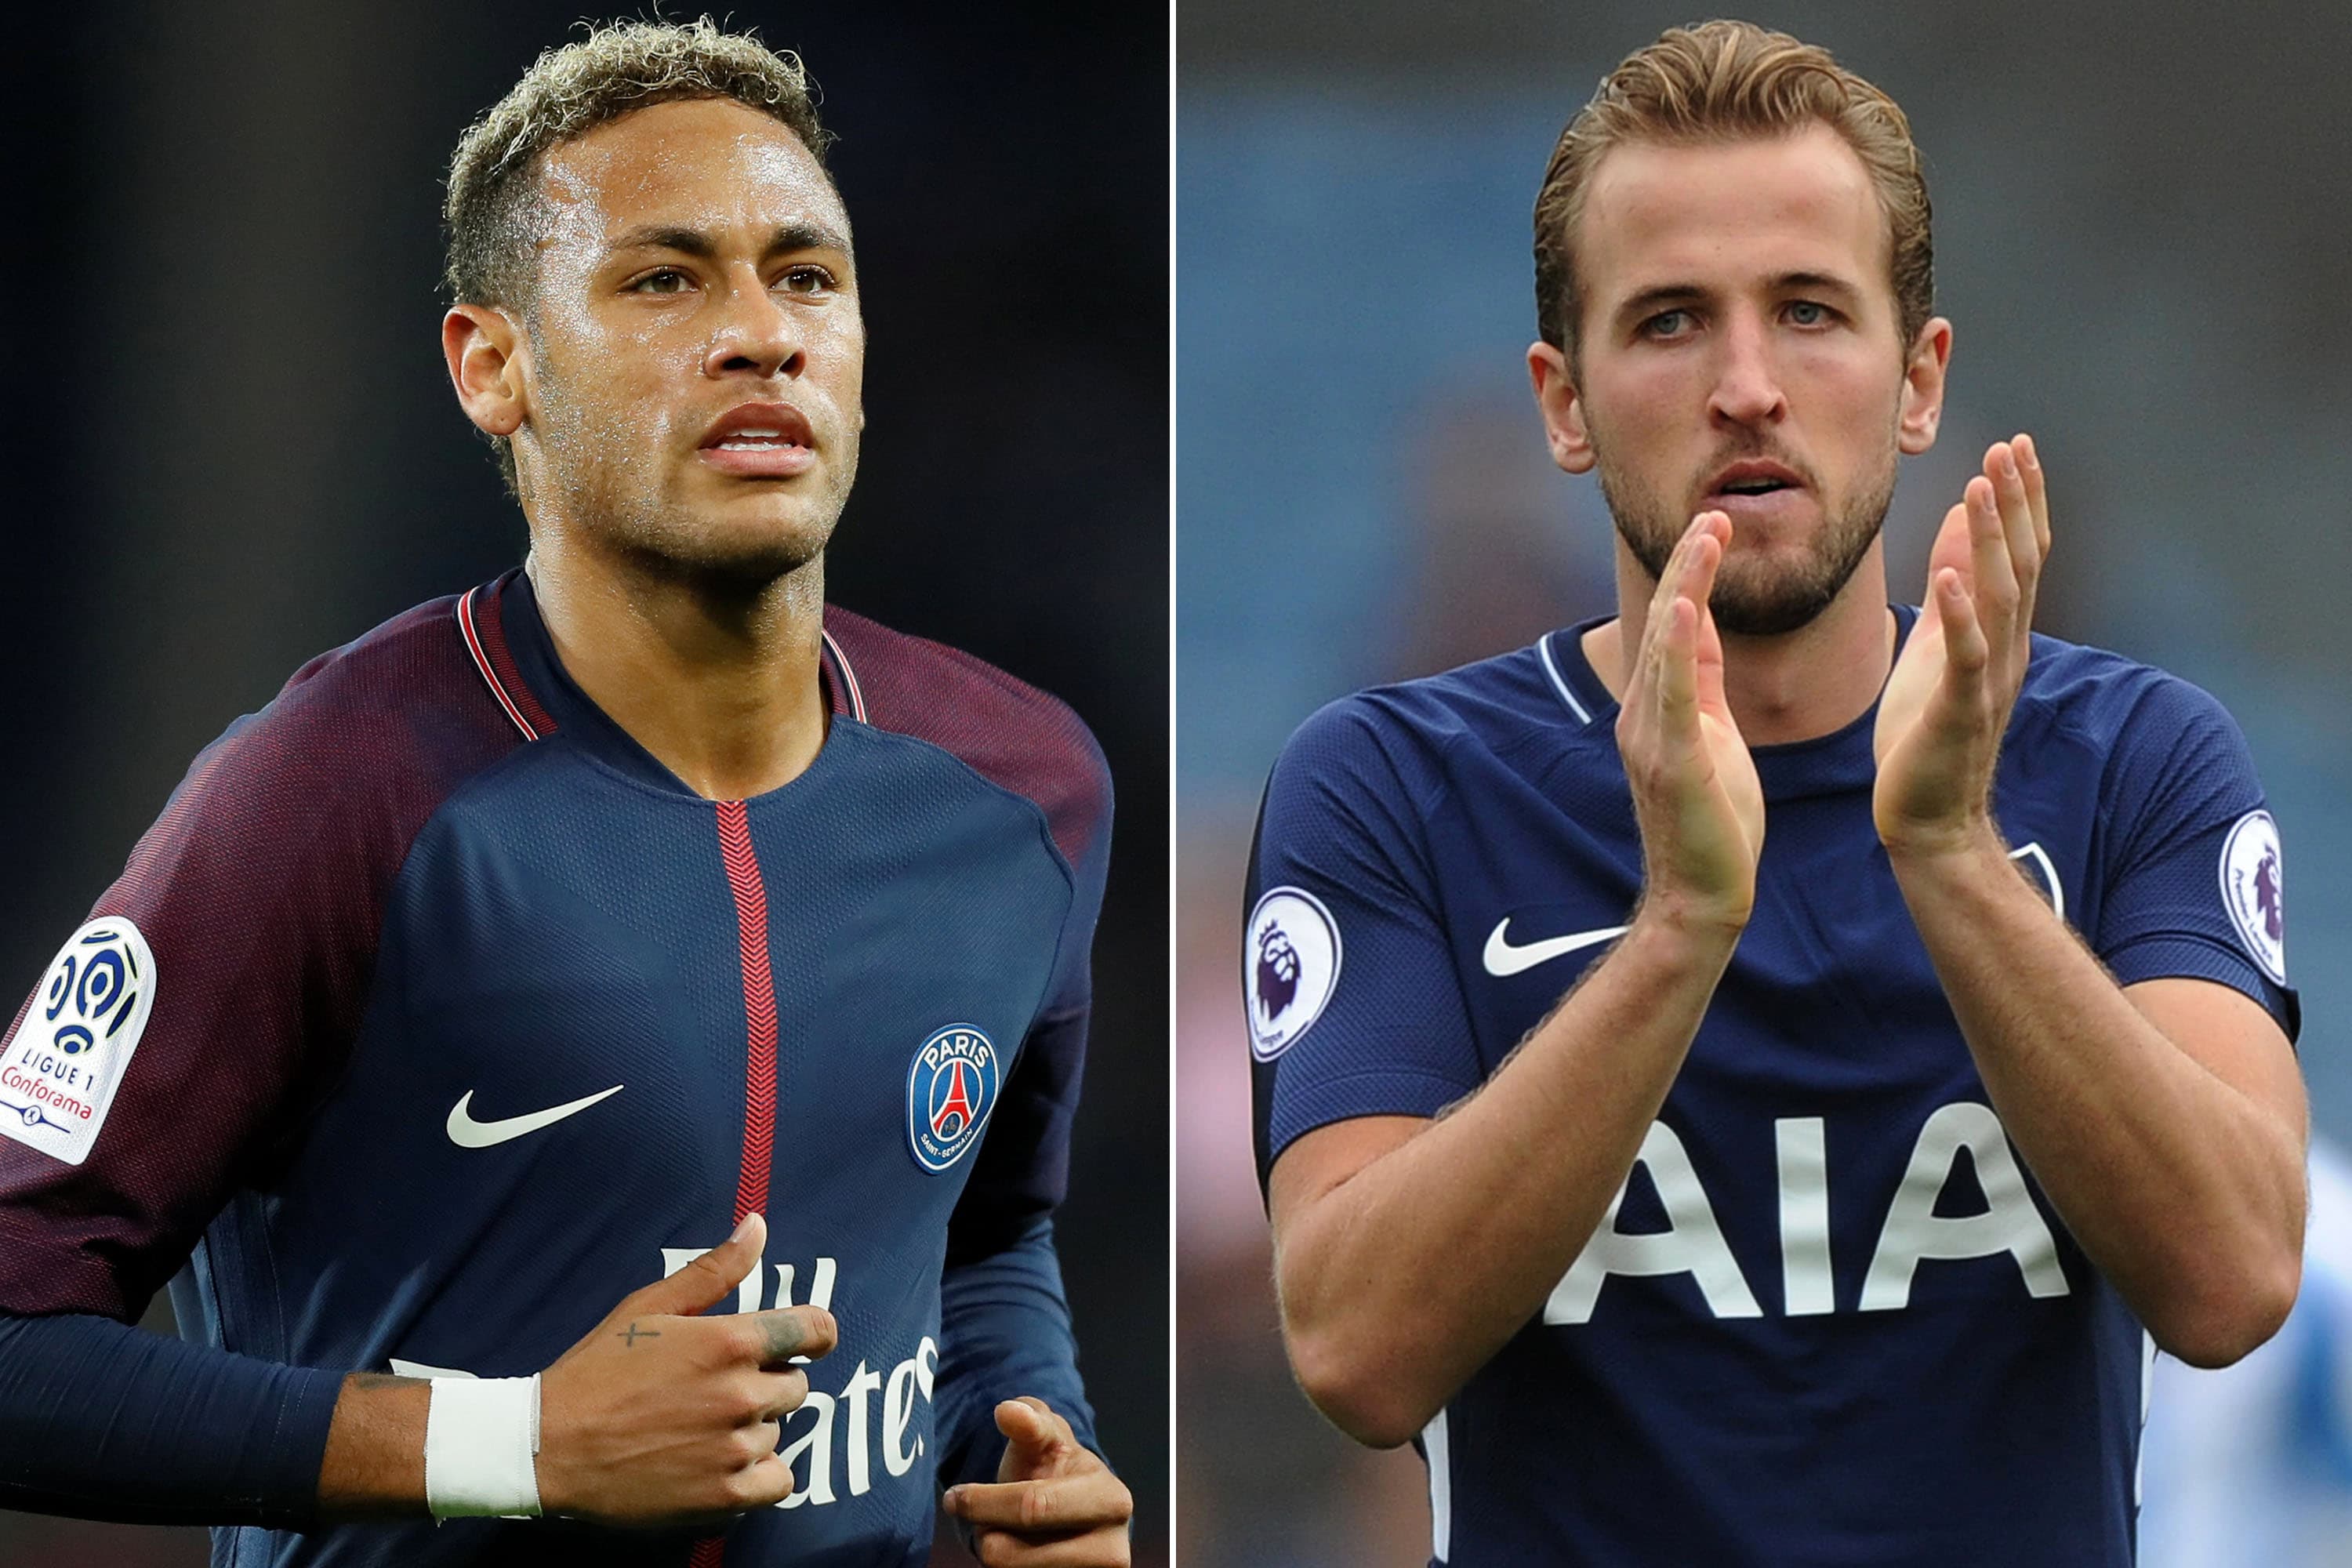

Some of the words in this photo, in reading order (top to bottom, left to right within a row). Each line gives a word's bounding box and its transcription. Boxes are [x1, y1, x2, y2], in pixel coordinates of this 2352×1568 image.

[21, 1048, 78, 1084] LIGUE
[85, 1075, 93, 1091] 1
[924, 1035, 989, 1071] PARIS
[2, 1066, 93, 1120] Conforama
[920, 1128, 973, 1158] SAINT-GERMAIN
[1543, 1102, 2071, 1325] AIA
